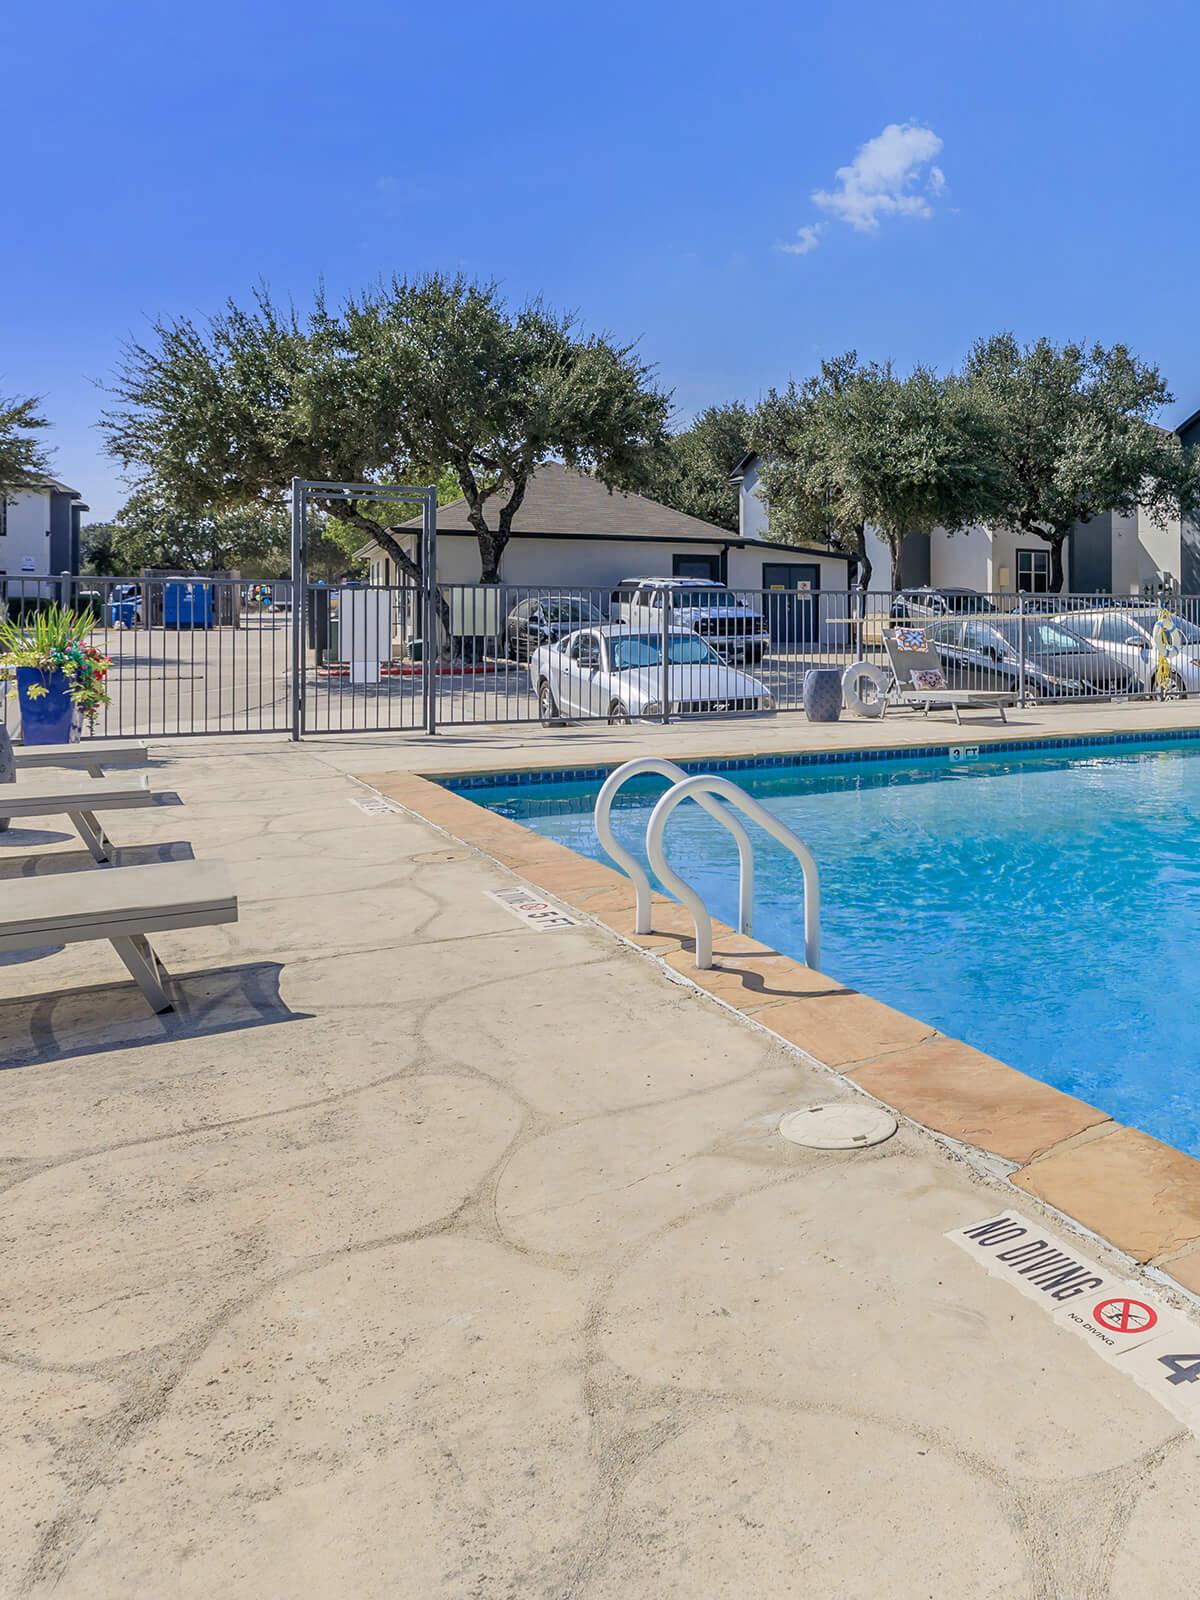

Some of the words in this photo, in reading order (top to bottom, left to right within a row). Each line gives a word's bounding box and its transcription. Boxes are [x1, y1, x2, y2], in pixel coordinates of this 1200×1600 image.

[536, 917, 576, 928] FT
[963, 1217, 1028, 1247] NO
[996, 1239, 1103, 1302] DIVING
[1067, 1313, 1084, 1324] NO
[1082, 1323, 1115, 1346] DIVING
